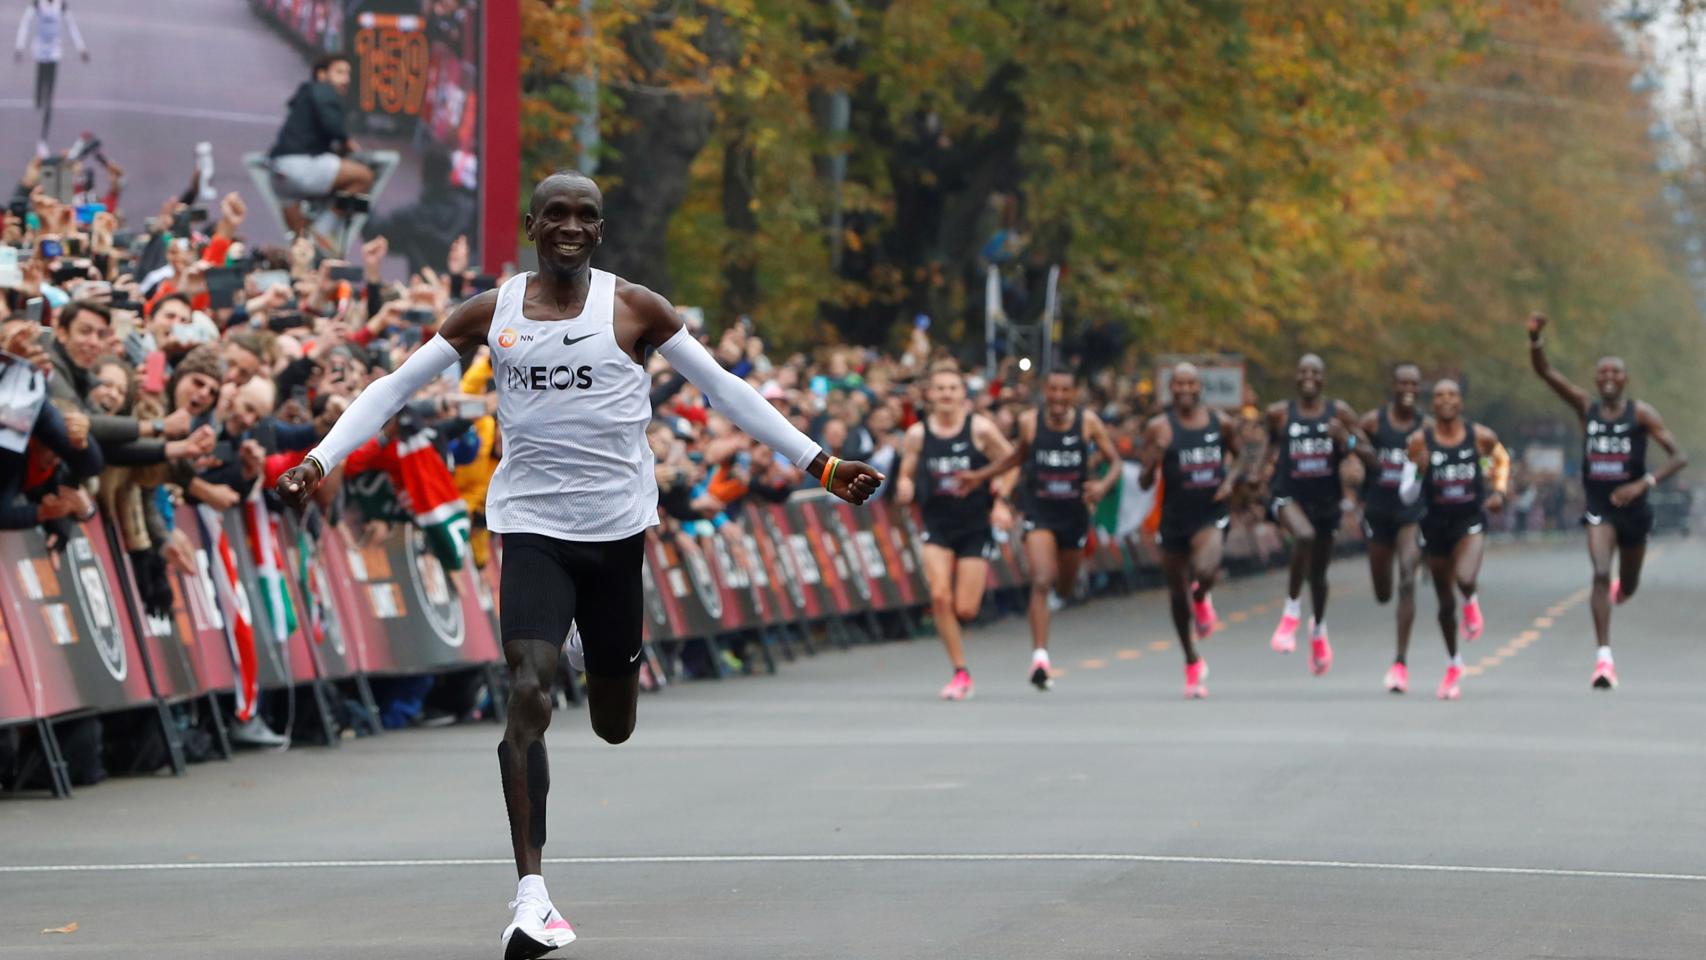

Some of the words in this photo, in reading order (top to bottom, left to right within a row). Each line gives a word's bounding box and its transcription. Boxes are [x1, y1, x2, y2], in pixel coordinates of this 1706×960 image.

[507, 365, 593, 391] INEOS
[1289, 438, 1334, 454] INEOS
[1587, 436, 1631, 454] INEOS
[1036, 450, 1082, 467] INEOS
[1179, 446, 1222, 465] INEOS
[1432, 463, 1476, 481] INEOS
